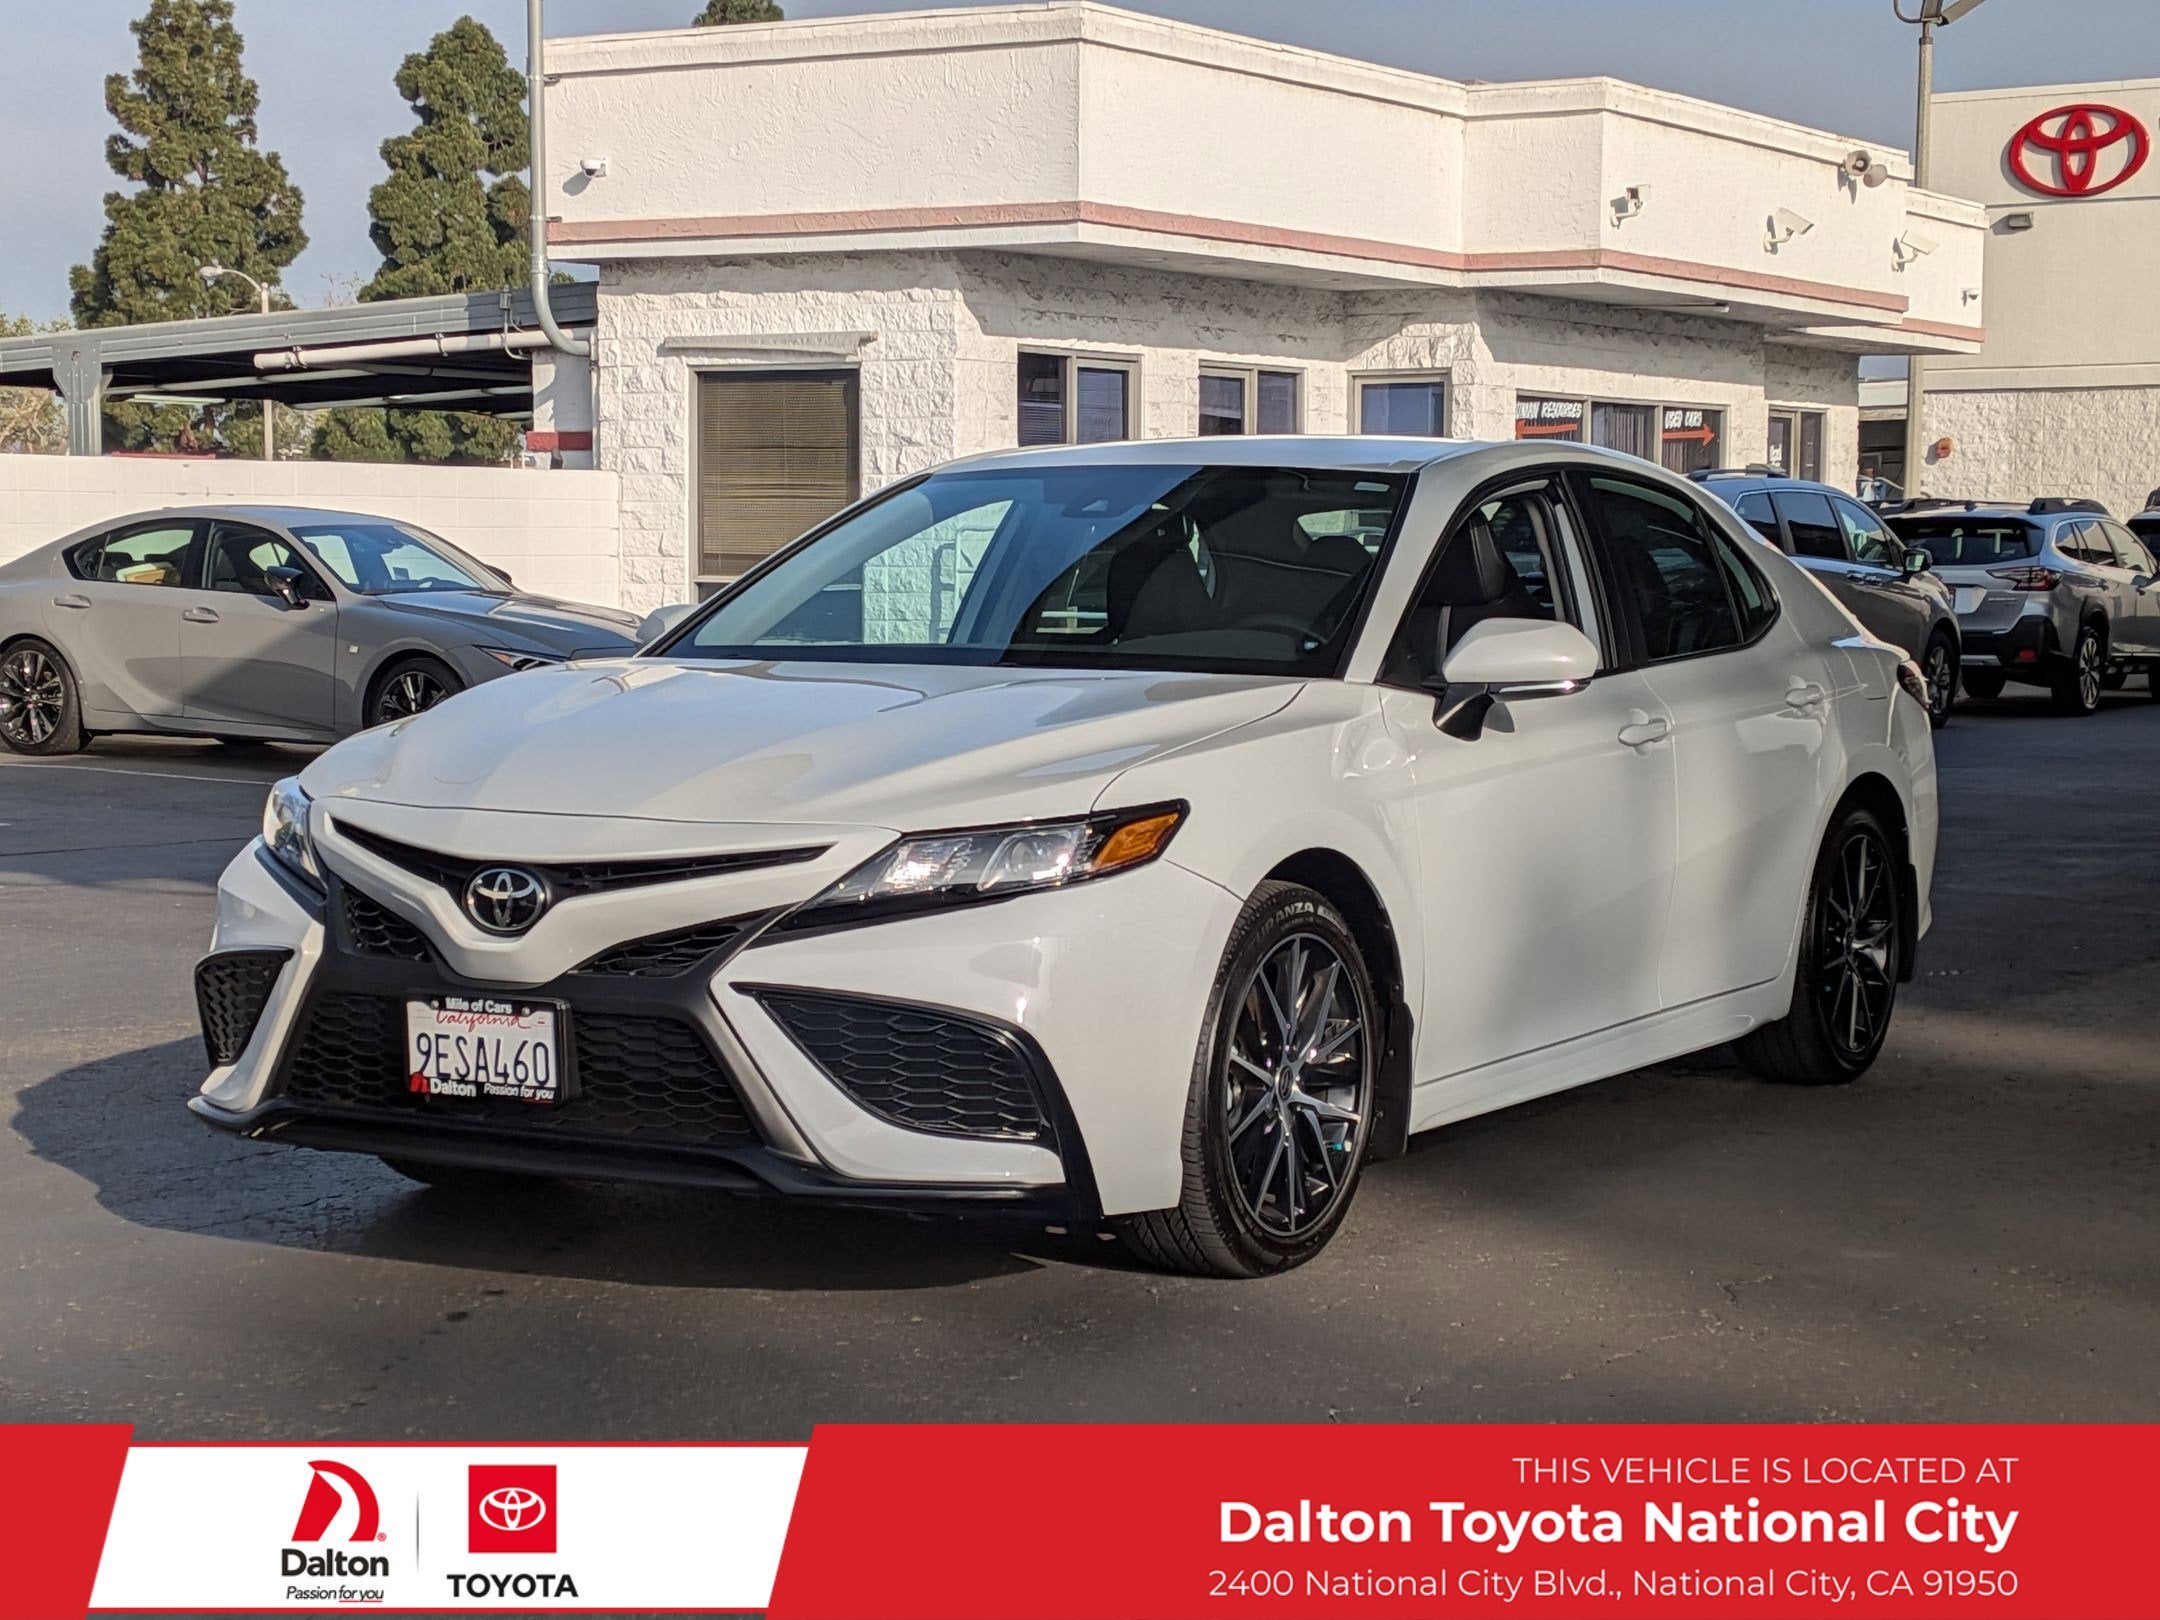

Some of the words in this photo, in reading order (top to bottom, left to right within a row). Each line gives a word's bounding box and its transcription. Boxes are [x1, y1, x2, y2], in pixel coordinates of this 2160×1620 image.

[1665, 410, 1682, 429] USED
[1685, 411, 1702, 427] CARS
[445, 997, 469, 1011] Mile
[473, 1000, 483, 1012] of
[485, 1001, 512, 1014] Cars
[416, 1032, 550, 1086] 9ESA460
[430, 1078, 477, 1097] Dalton
[483, 1083, 518, 1097] Passion
[520, 1086, 534, 1098] for
[536, 1088, 554, 1100] you
